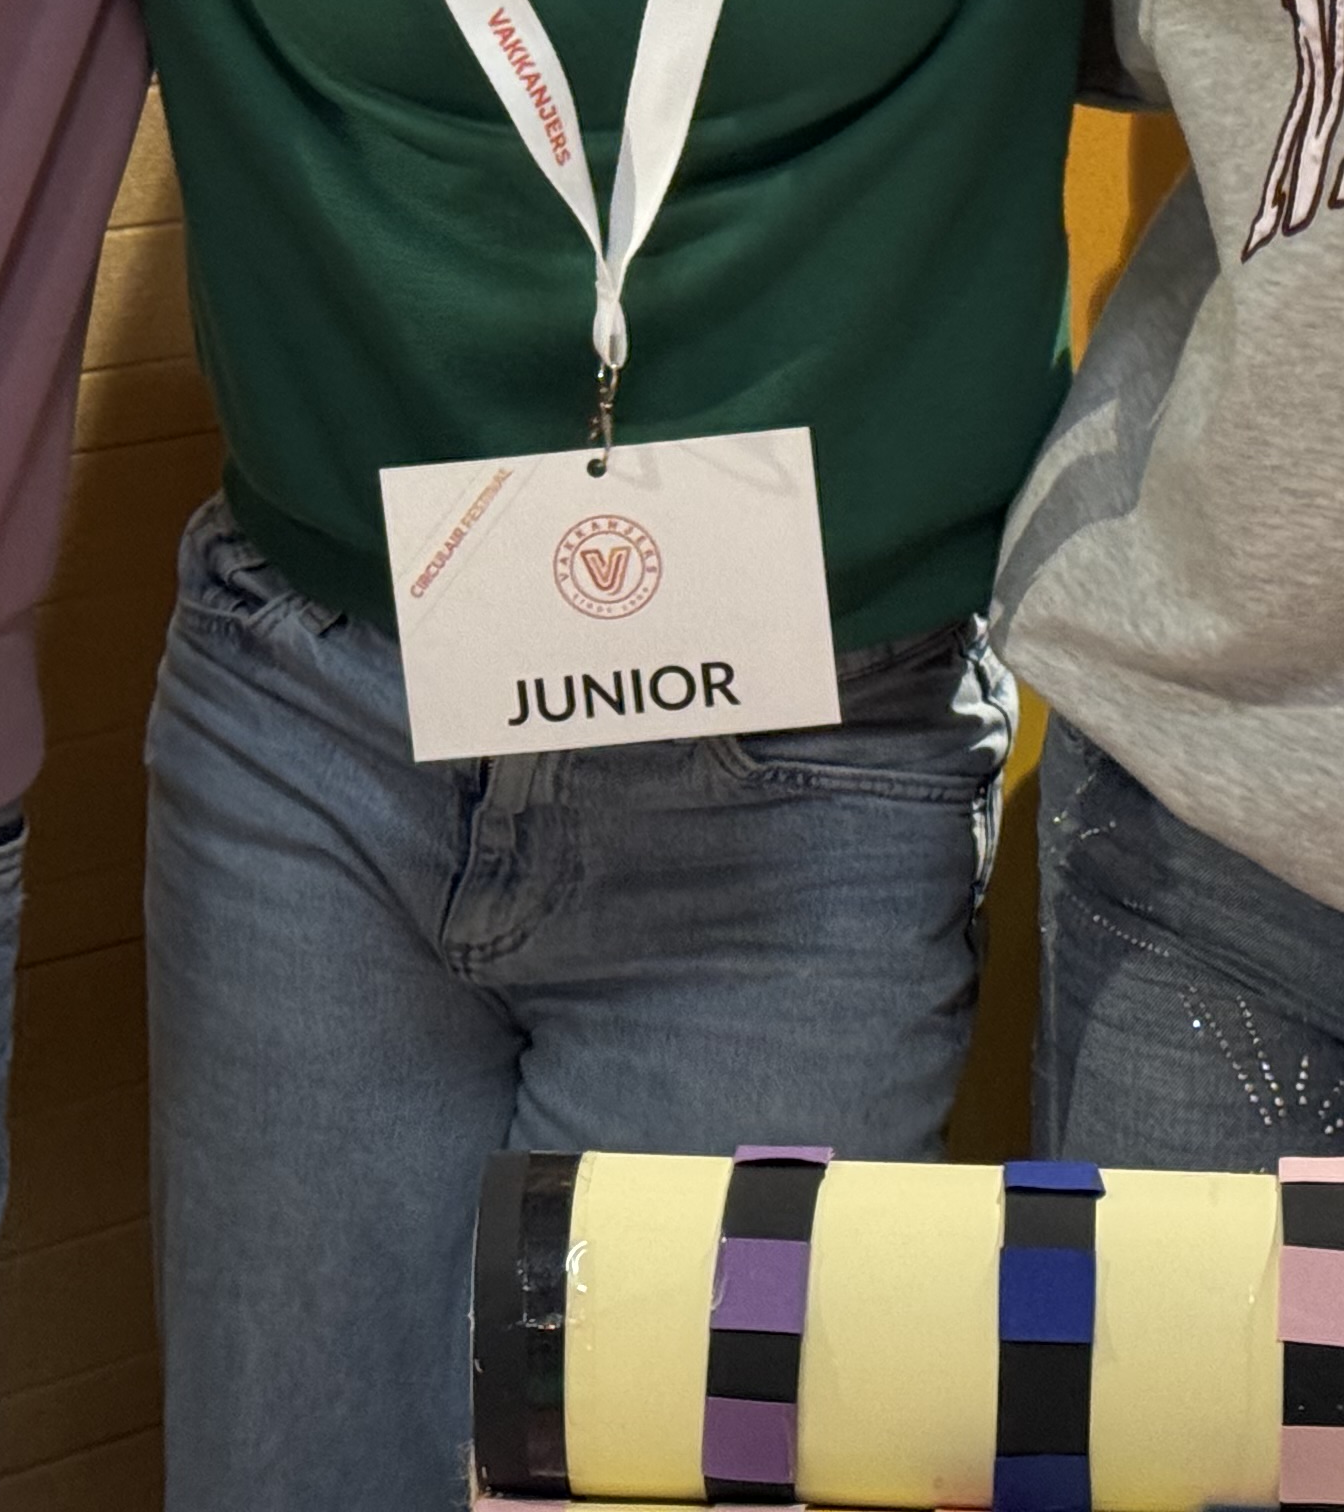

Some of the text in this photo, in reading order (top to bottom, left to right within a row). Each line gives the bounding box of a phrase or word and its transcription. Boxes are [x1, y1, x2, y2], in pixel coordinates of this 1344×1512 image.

[487, 6, 572, 167] VAKKANJERS
[410, 527, 468, 598] CIRCULAIR
[508, 661, 741, 727] JUNIOR
